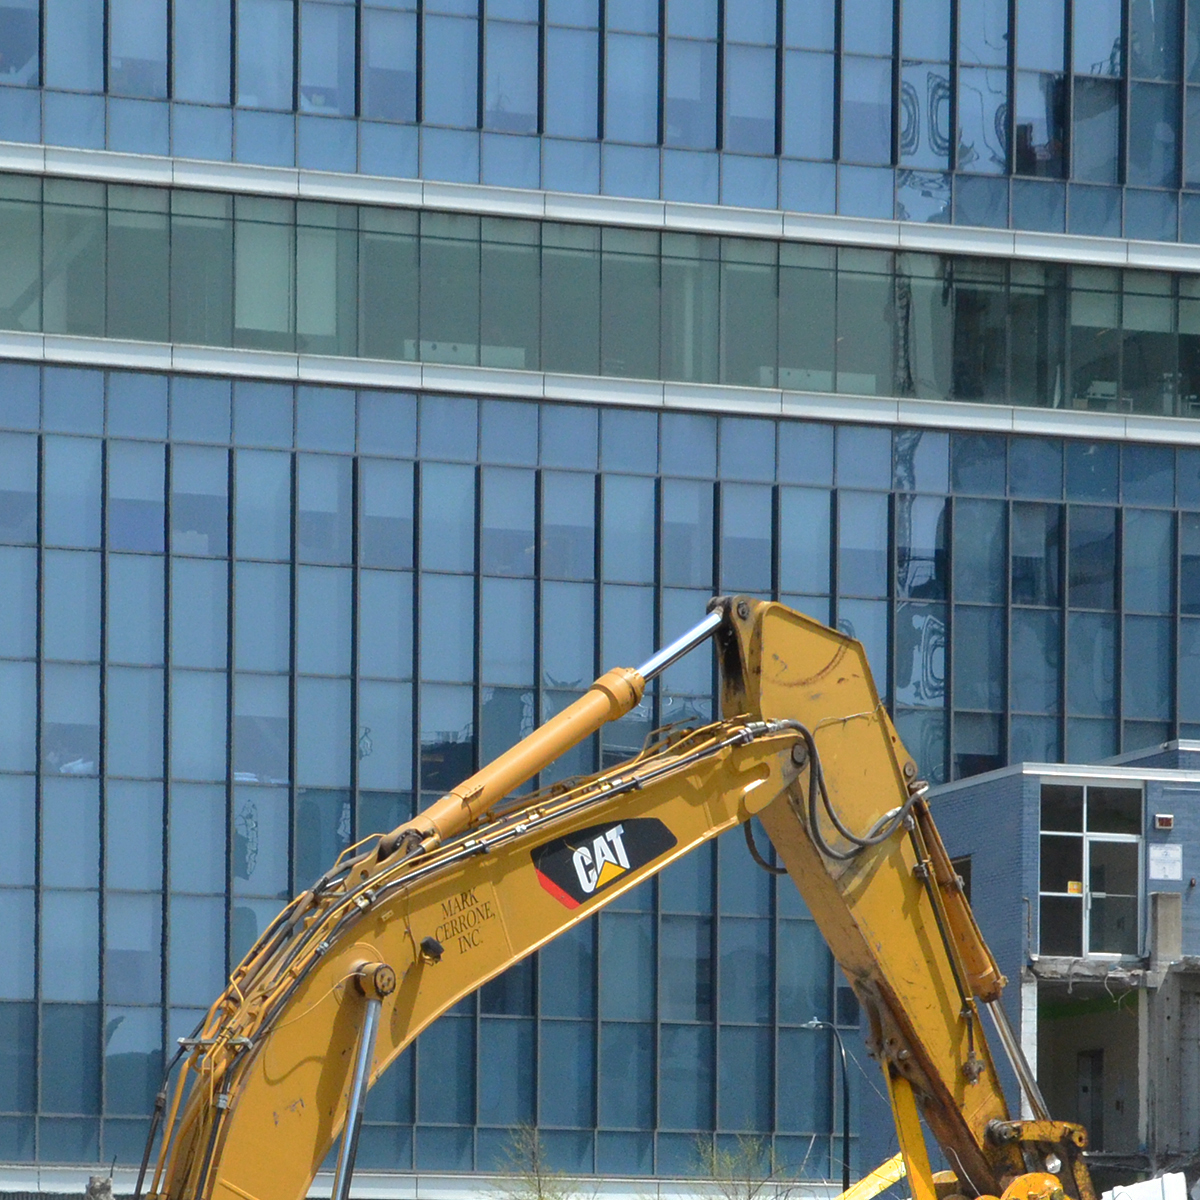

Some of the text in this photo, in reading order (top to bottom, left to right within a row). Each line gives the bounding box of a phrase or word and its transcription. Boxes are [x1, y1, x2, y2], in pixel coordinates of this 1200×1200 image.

[572, 824, 631, 893] CAT
[435, 901, 496, 943] CERRONE,
[441, 886, 479, 920] MARK
[458, 929, 484, 954] INC.
